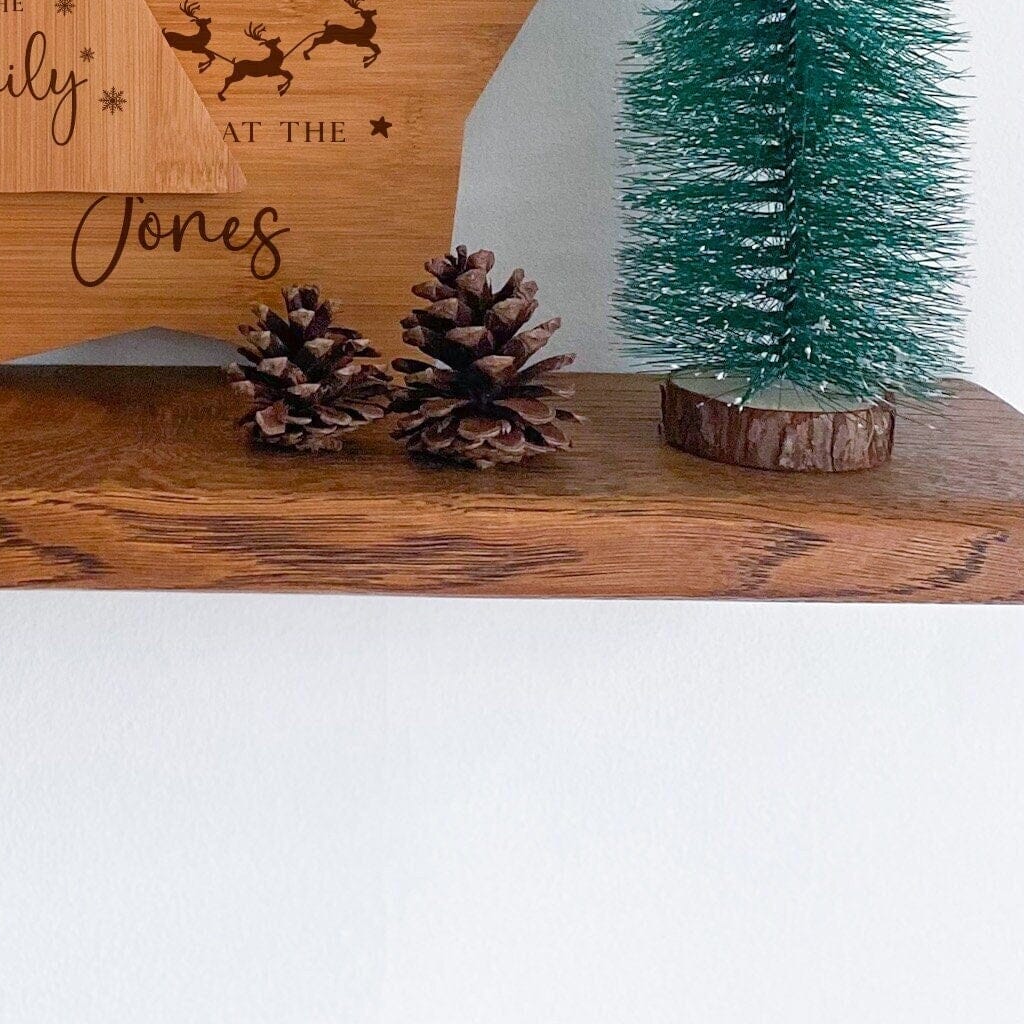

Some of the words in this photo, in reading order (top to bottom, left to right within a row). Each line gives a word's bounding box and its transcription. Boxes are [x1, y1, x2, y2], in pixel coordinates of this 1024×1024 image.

[222, 121, 262, 144] AT
[279, 121, 347, 144] THE
[70, 195, 291, 288] Jones
